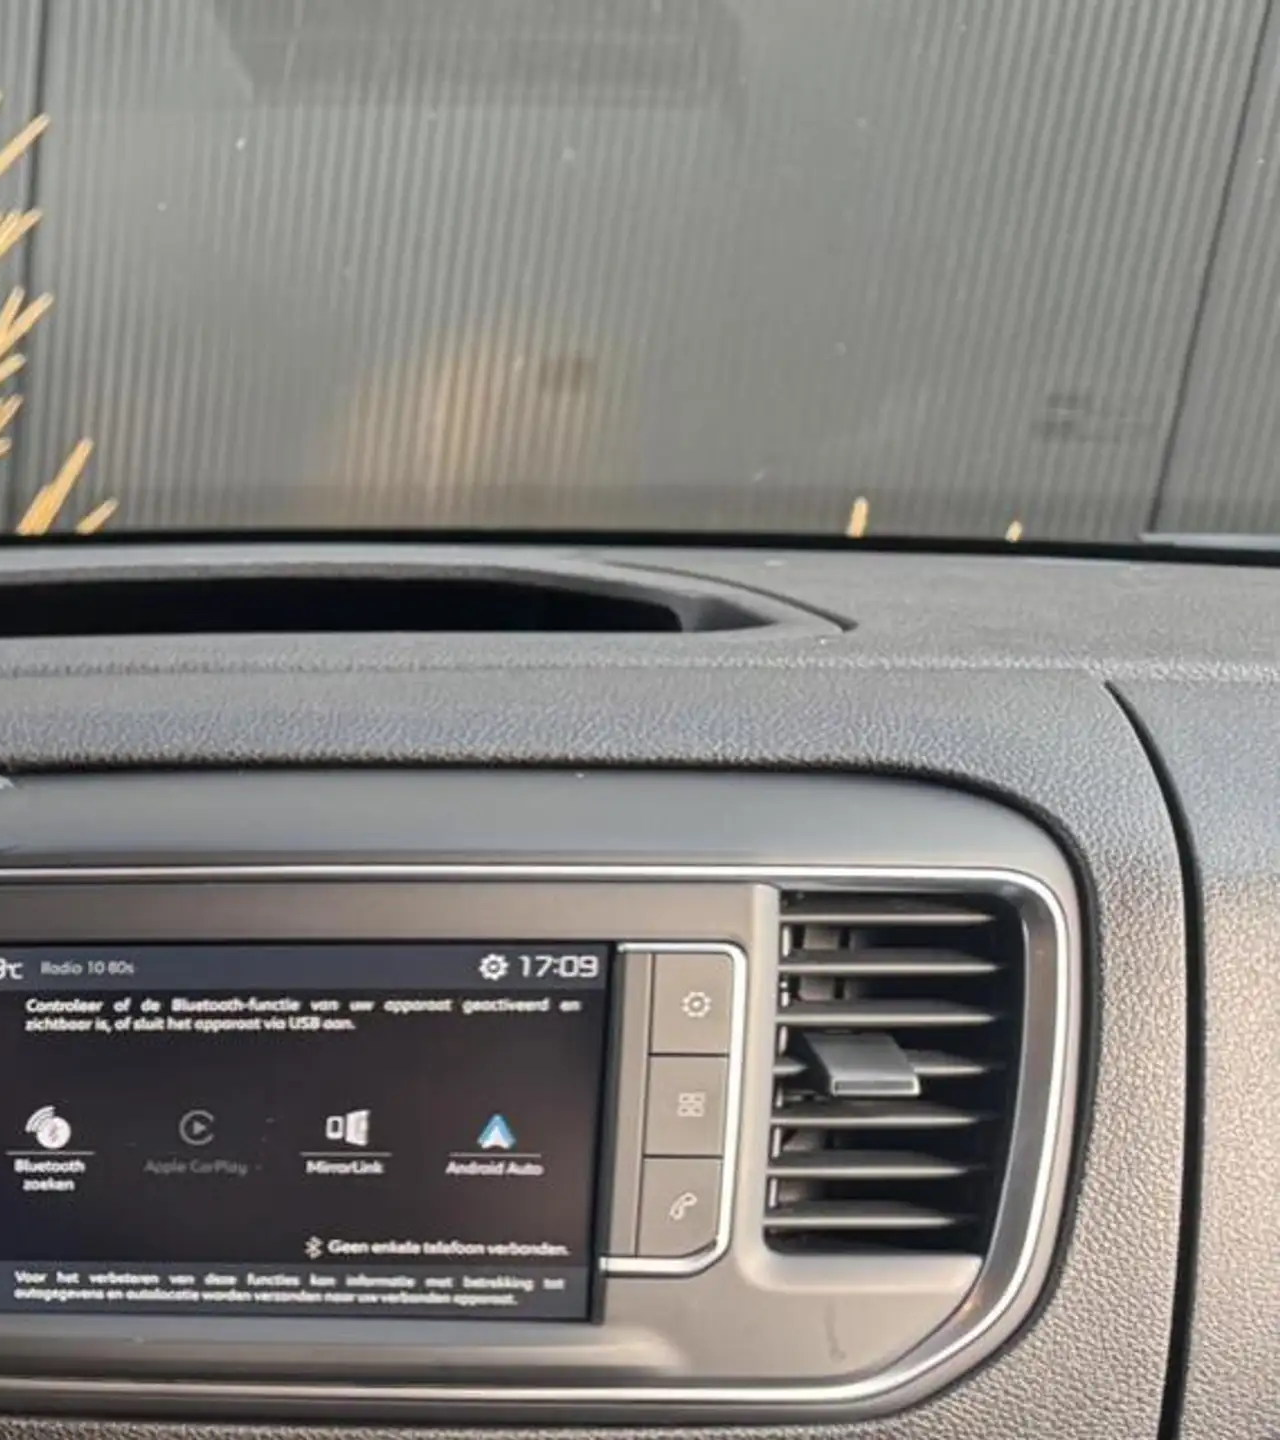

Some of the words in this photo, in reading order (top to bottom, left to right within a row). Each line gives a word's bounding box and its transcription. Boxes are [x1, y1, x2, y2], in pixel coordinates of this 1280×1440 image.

[40, 960, 83, 976] Radio
[87, 960, 105, 976] 10
[518, 954, 600, 979] 17:09
[25, 998, 103, 1014] Controleer
[113, 998, 131, 1013] of
[140, 999, 160, 1013] de
[170, 998, 301, 1014] Bluetooth-functie
[309, 1000, 340, 1013] van
[348, 1001, 374, 1013] uw
[383, 999, 453, 1016] apparaat
[25, 1016, 93, 1032] zichtbaar
[115, 1016, 133, 1032] of
[134, 1016, 164, 1032] sluit
[167, 1016, 191, 1032] het
[194, 1016, 261, 1034] apparaat
[263, 1016, 286, 1032] via
[288, 1017, 320, 1031] USB
[13, 1158, 87, 1174] Bluetooth
[142, 1159, 186, 1175] Apple
[189, 1159, 249, 1177] CarPlay
[305, 1160, 385, 1175] MirrorLink
[444, 1160, 504, 1176] Android
[506, 1161, 545, 1176] Auto
[22, 1177, 76, 1192] zoeken
[327, 1238, 370, 1254] Geen
[371, 1239, 421, 1255] enkele
[423, 1240, 485, 1256] telefoon
